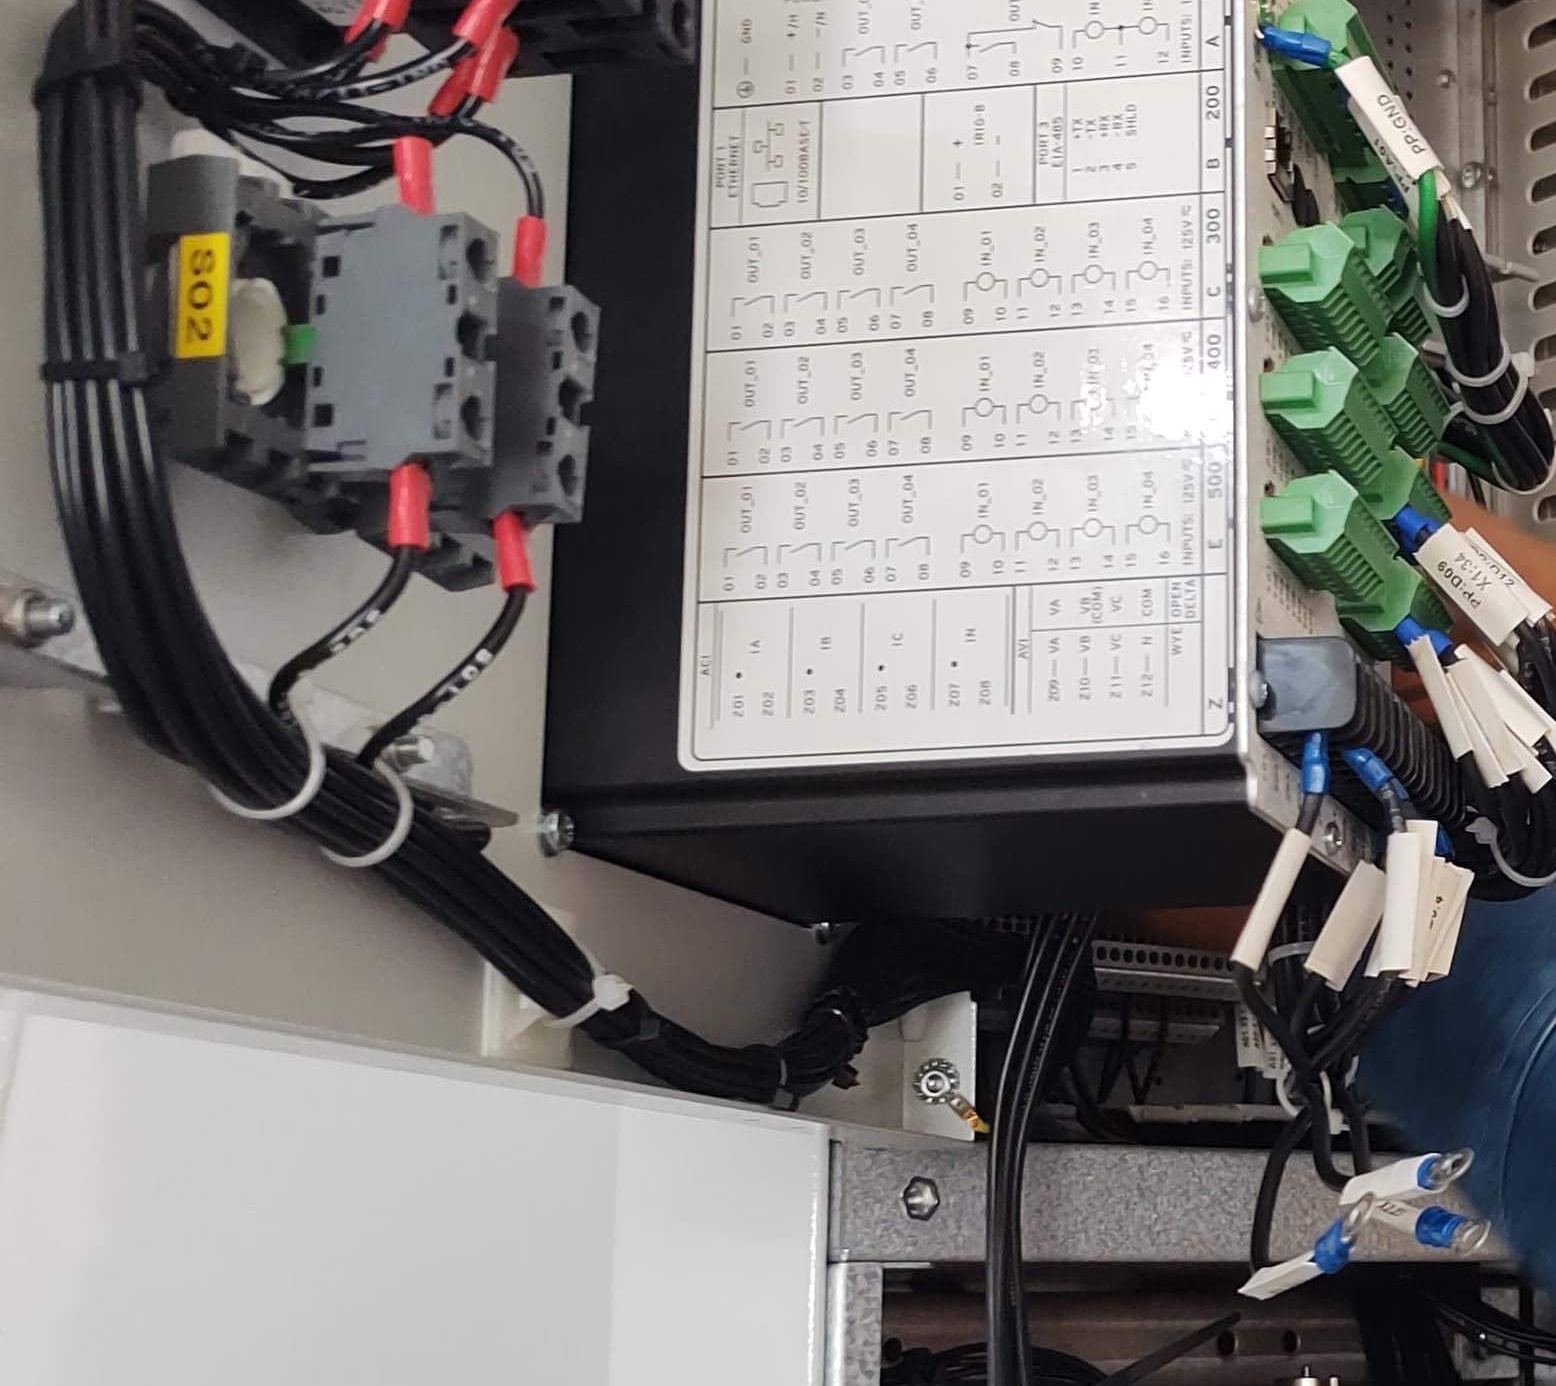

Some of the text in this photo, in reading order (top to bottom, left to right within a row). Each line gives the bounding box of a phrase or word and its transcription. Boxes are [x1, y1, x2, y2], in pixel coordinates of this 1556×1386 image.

[741, 19, 752, 44] GND
[1205, 36, 1219, 47] A
[1072, 57, 1083, 70] 10
[1157, 51, 1169, 64] 12
[812, 77, 824, 92] 02
[842, 75, 853, 90] 03
[967, 65, 978, 80] 07
[786, 80, 796, 95] 01
[1206, 85, 1220, 169] B 200
[1377, 94, 1427, 155] PP:GND
[980, 231, 994, 266] IN_01
[1142, 218, 1156, 255] IN_04
[747, 237, 761, 283] OUT_01
[1206, 208, 1221, 297] C 300
[1207, 334, 1221, 369] 400
[1207, 461, 1223, 549] E 500
[1437, 560, 1482, 609] PP:D09
[1454, 552, 1493, 591] X1:34
[1049, 599, 1061, 616] VA
[1110, 597, 1122, 613] VC
[1141, 588, 1153, 617] COM
[1171, 582, 1182, 618] OPEN
[1184, 579, 1196, 619] DELTA
[1110, 634, 1122, 651] VC
[1171, 628, 1183, 655] WYE
[1048, 637, 1060, 702] Z09 VA
[1079, 677, 1091, 700] Z10
[1141, 674, 1153, 697] Z12
[1208, 698, 1223, 709] Z
